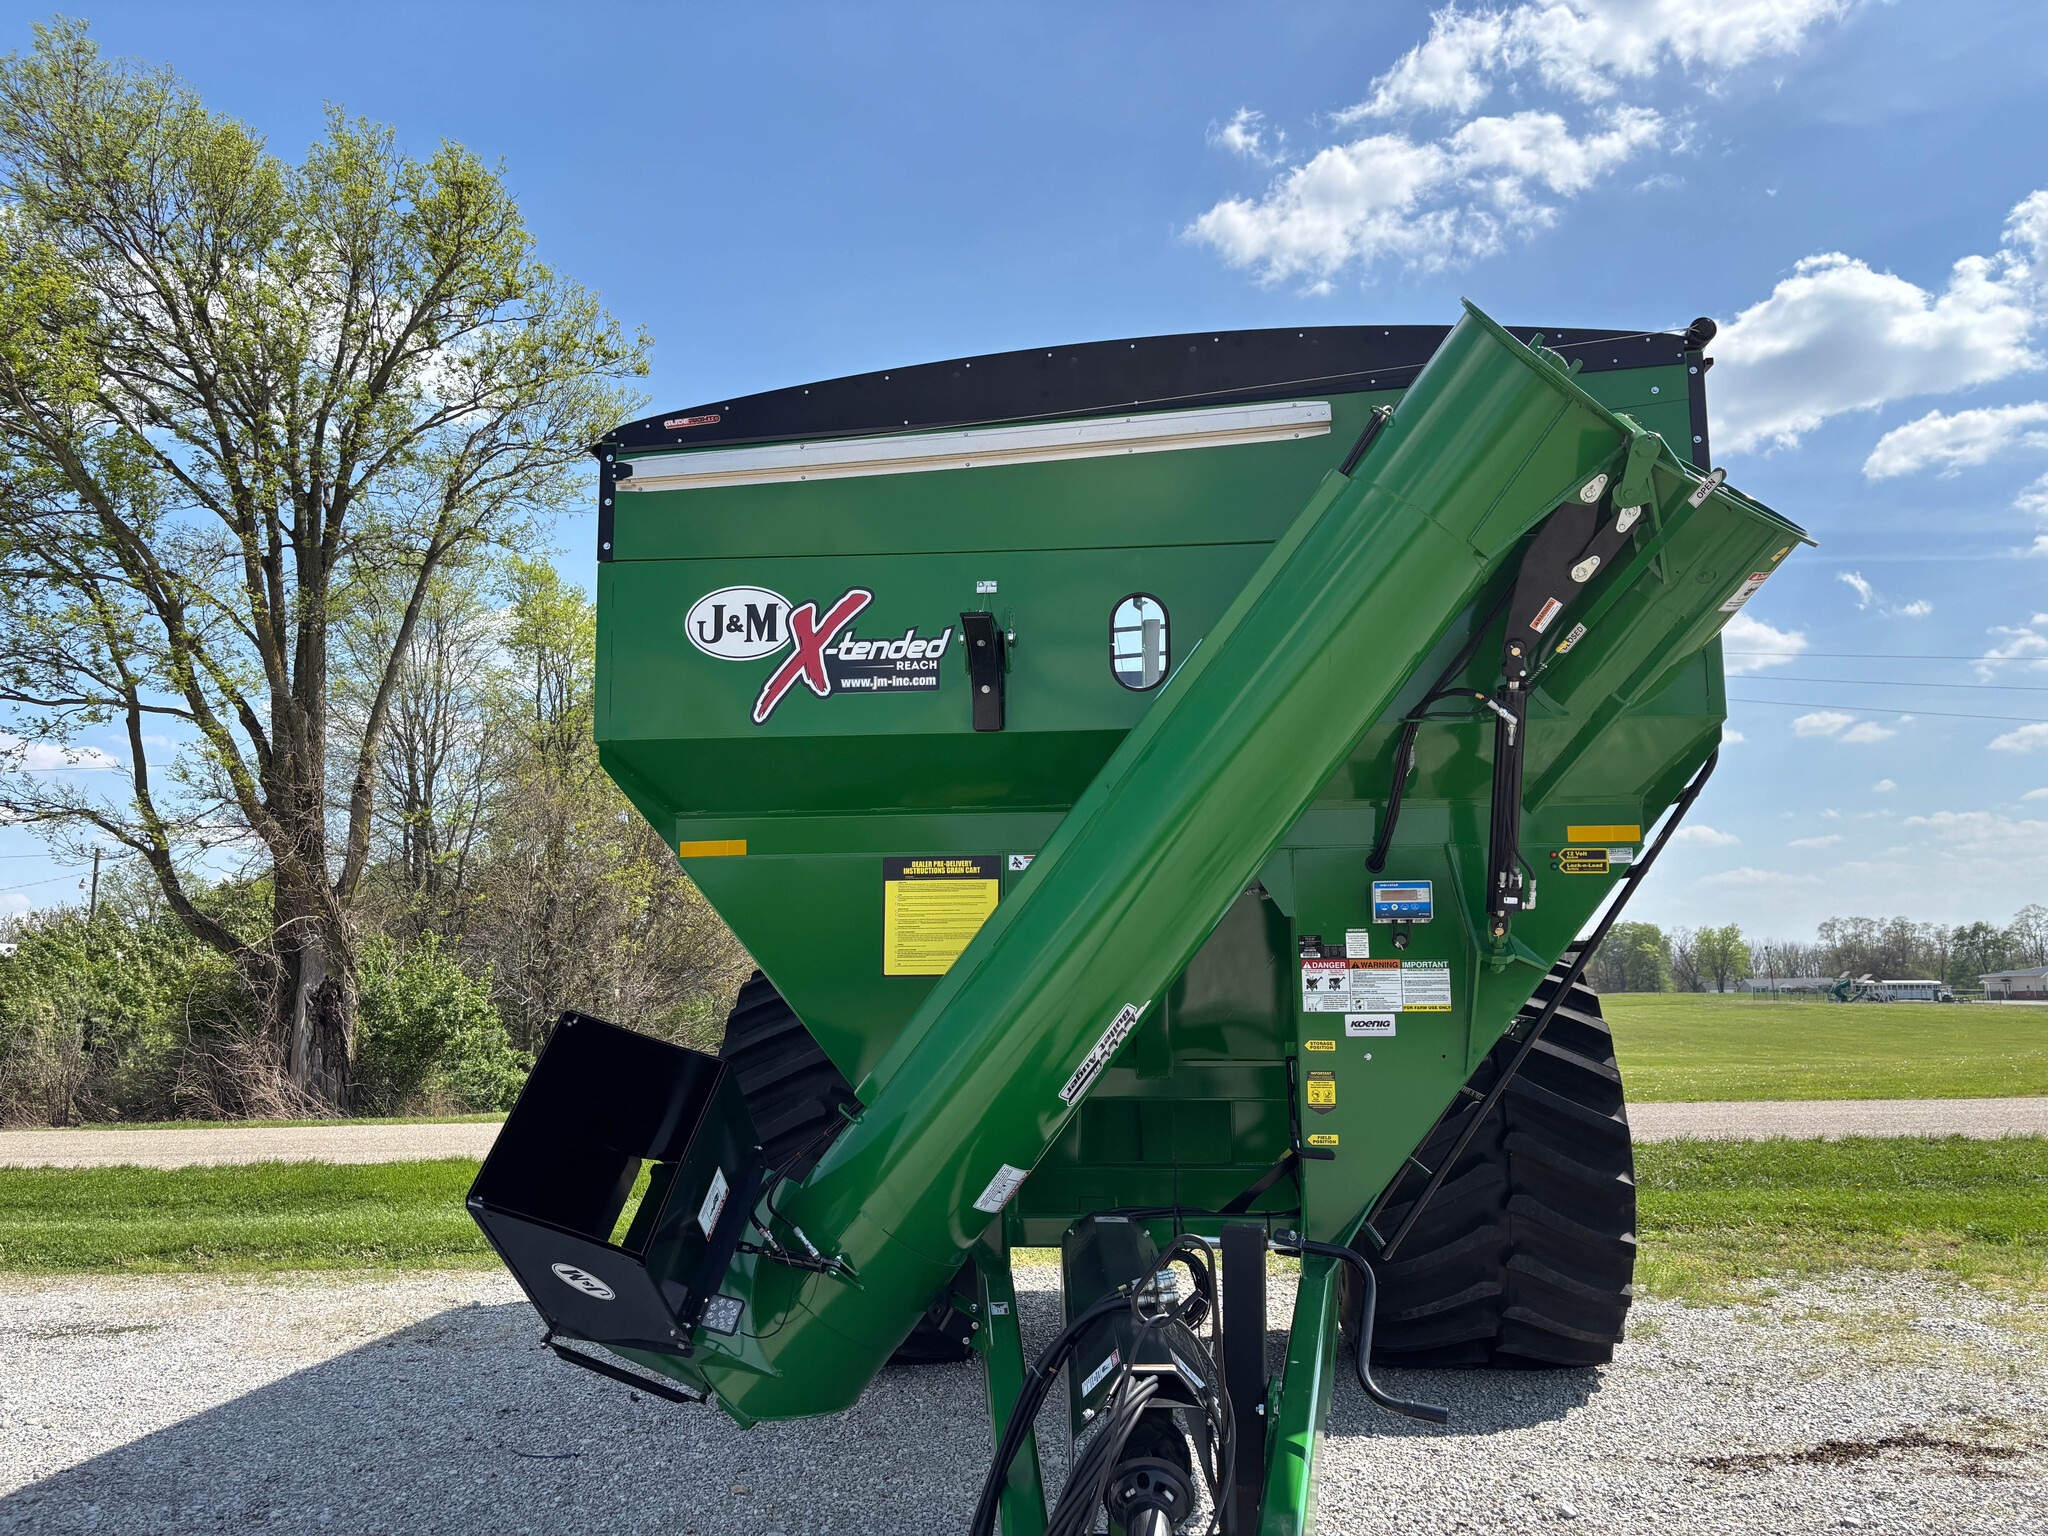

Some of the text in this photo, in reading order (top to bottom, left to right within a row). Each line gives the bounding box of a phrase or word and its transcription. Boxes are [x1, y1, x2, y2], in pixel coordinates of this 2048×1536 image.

[1696, 478, 1716, 499] OPEN
[697, 603, 779, 644] J&M
[896, 660, 938, 671] REACH
[840, 675, 936, 690] www.jm-inc.com
[903, 867, 946, 875] INSTRUCTIONS
[965, 866, 981, 874] CART
[911, 860, 973, 868] DEALER PRE-DELIVERY
[1312, 961, 1346, 969] DANGER
[1360, 961, 1399, 969] WARNING
[1066, 1008, 1131, 1096] Bullet Auger
[557, 1269, 611, 1297] J&M
